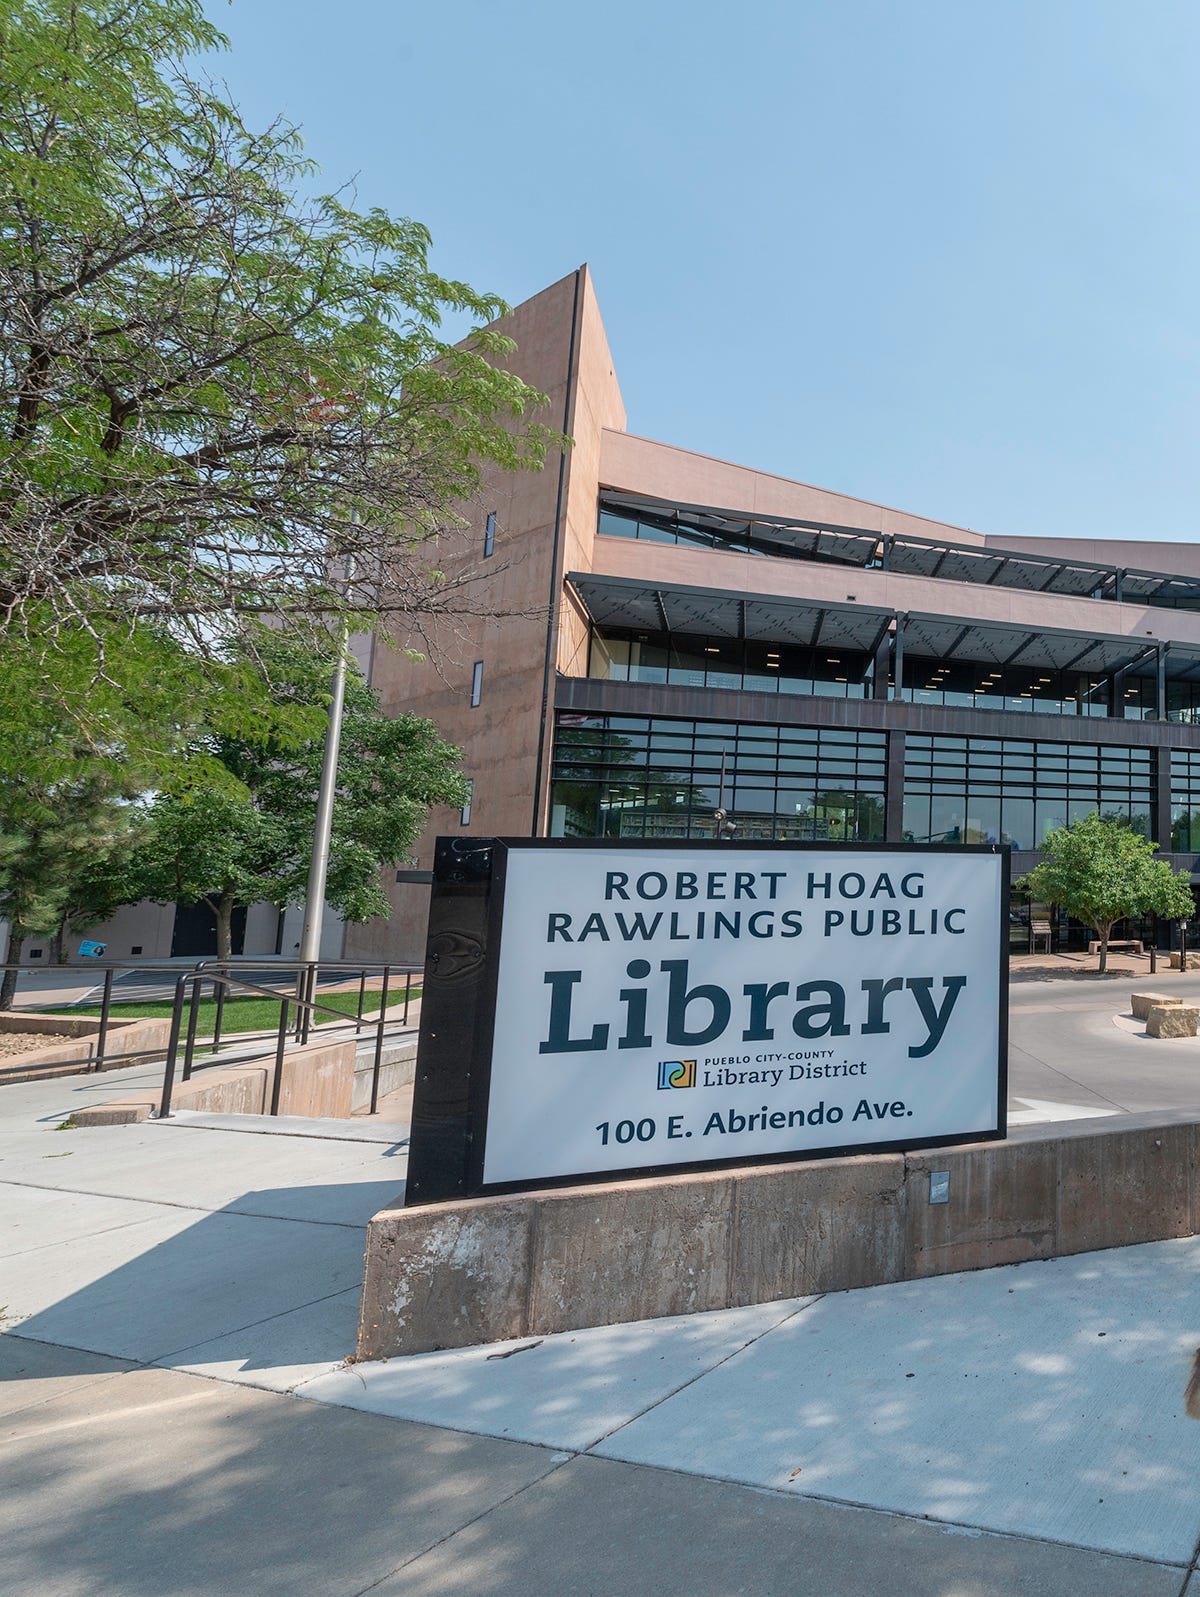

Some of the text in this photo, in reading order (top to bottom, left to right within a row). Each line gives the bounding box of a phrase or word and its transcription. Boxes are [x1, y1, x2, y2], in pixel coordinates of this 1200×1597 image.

[604, 871, 925, 901] ROBERT HOAG
[546, 908, 966, 943] RAWLINGS PUBLIC
[538, 958, 968, 1059] Library
[703, 1060, 868, 1087] Library District
[704, 1050, 834, 1066] PUEBLO CITY-COUNTY
[594, 1099, 913, 1146] 100 E. Abriendo Ave.
